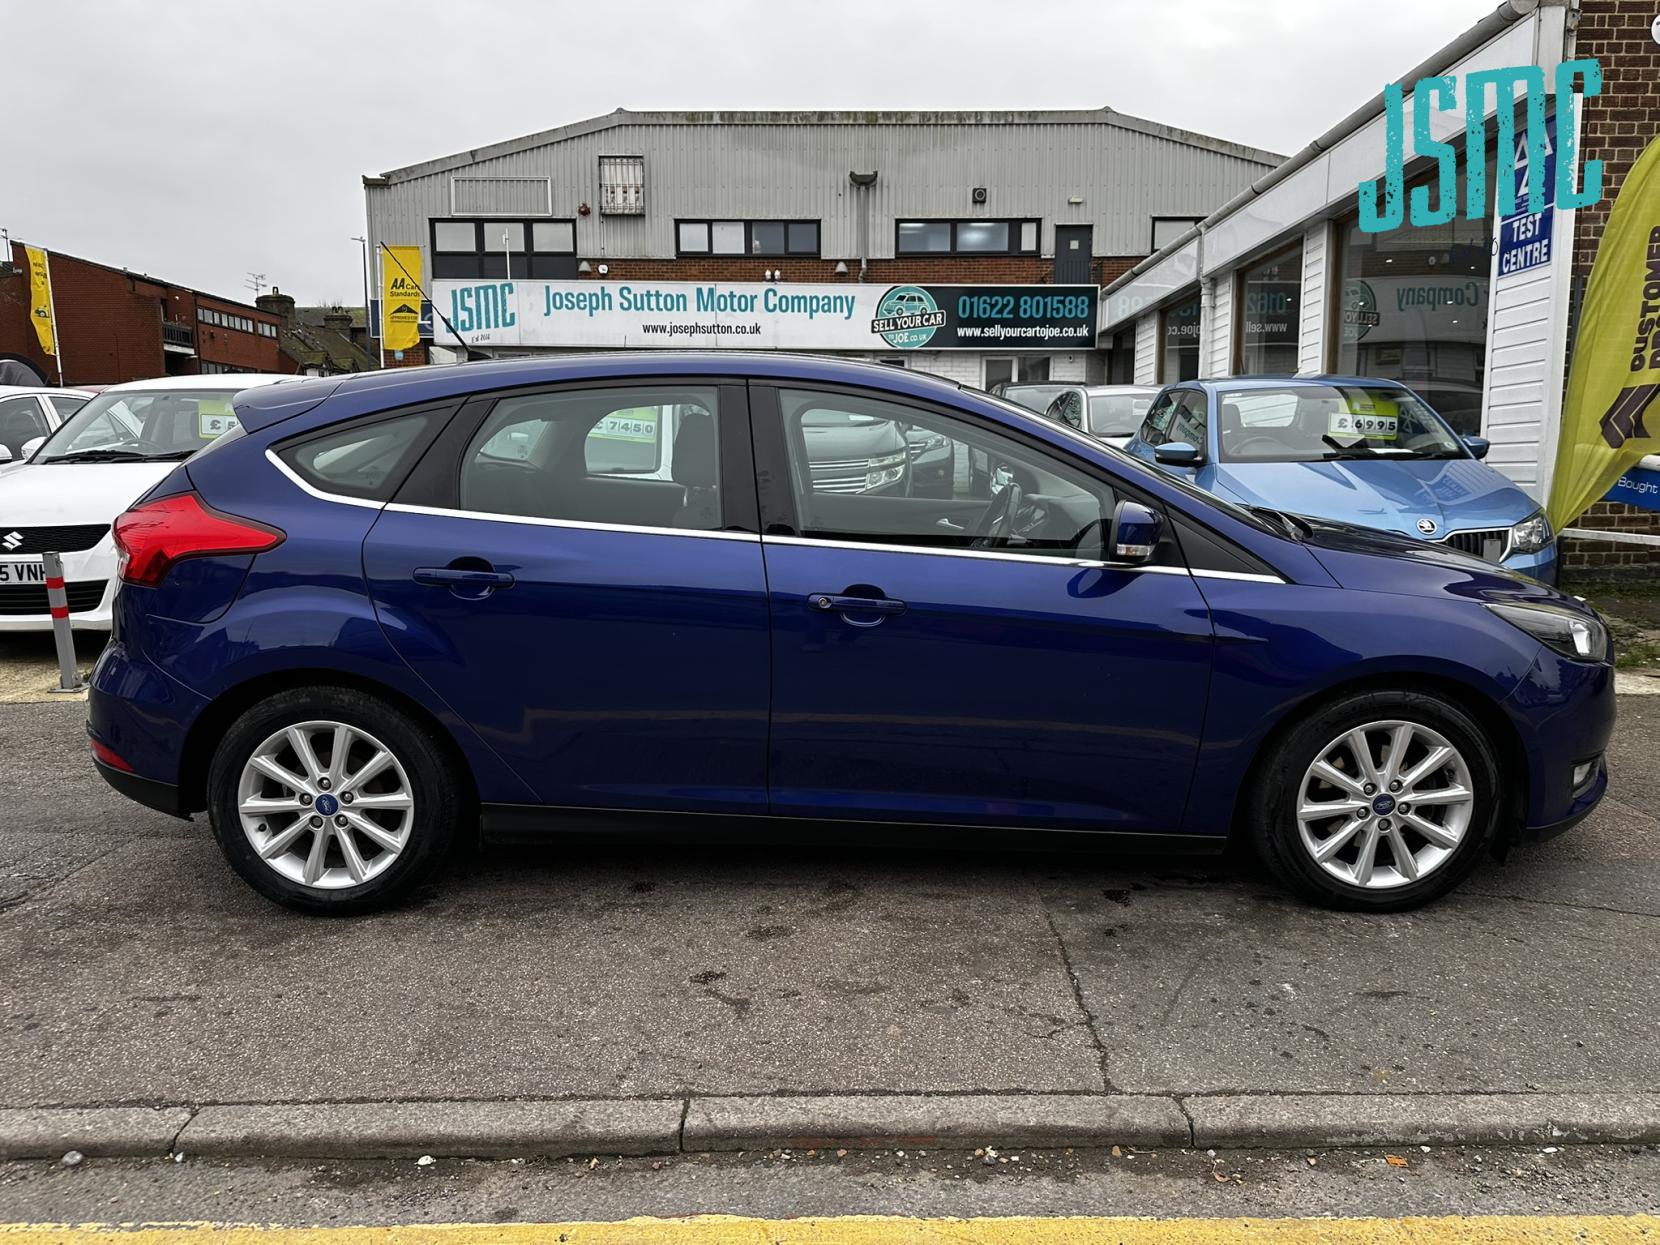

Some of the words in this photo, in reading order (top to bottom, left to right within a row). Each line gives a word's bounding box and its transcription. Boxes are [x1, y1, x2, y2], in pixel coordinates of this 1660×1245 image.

[1513, 213, 1542, 243] TEST
[1503, 238, 1549, 274] CENTRE
[391, 278, 405, 290] AA
[445, 283, 515, 333] JSMC
[544, 285, 613, 317] Joseph
[619, 286, 687, 311] Sutton
[696, 287, 758, 312] Motor
[764, 288, 856, 320] Company
[958, 295, 1015, 318] 01622
[1019, 295, 1089, 318] 801588
[642, 322, 761, 337] www.josephsutton.co.uk
[873, 320, 895, 332] SELL
[896, 315, 922, 329] YOUR
[922, 313, 942, 326] CAR
[957, 324, 1089, 340] www.sellyourcartojoe.co.uk
[1617, 476, 1658, 494] Bought
